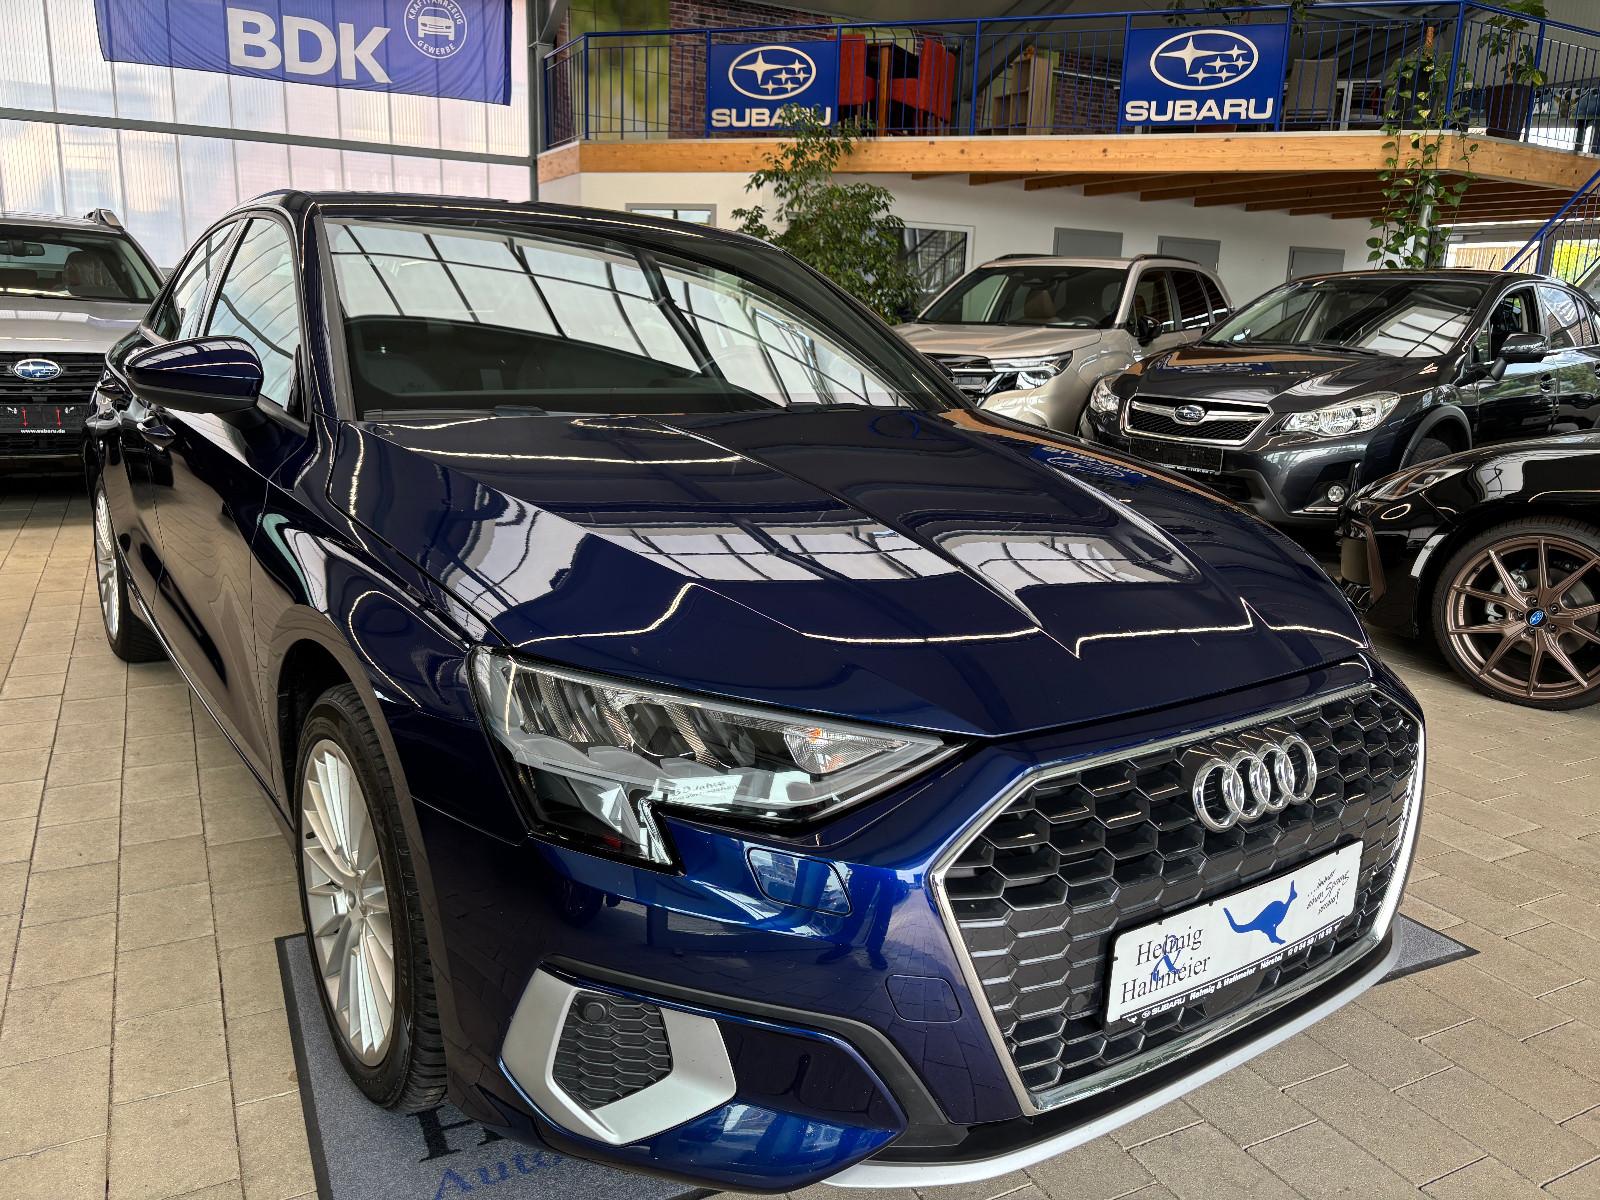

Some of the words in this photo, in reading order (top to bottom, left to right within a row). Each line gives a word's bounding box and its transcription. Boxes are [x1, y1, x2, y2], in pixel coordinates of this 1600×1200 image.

[226, 8, 392, 83] BDK
[417, 40, 456, 55] GEWERBE
[1125, 97, 1274, 122] SUBARU
[1135, 926, 1203, 967] Helmig
[1120, 956, 1211, 1005] Hallmeier
[1151, 997, 1186, 1016] SUBARU
[1189, 984, 1216, 1001] Helmig
[1215, 982, 1223, 990] &
